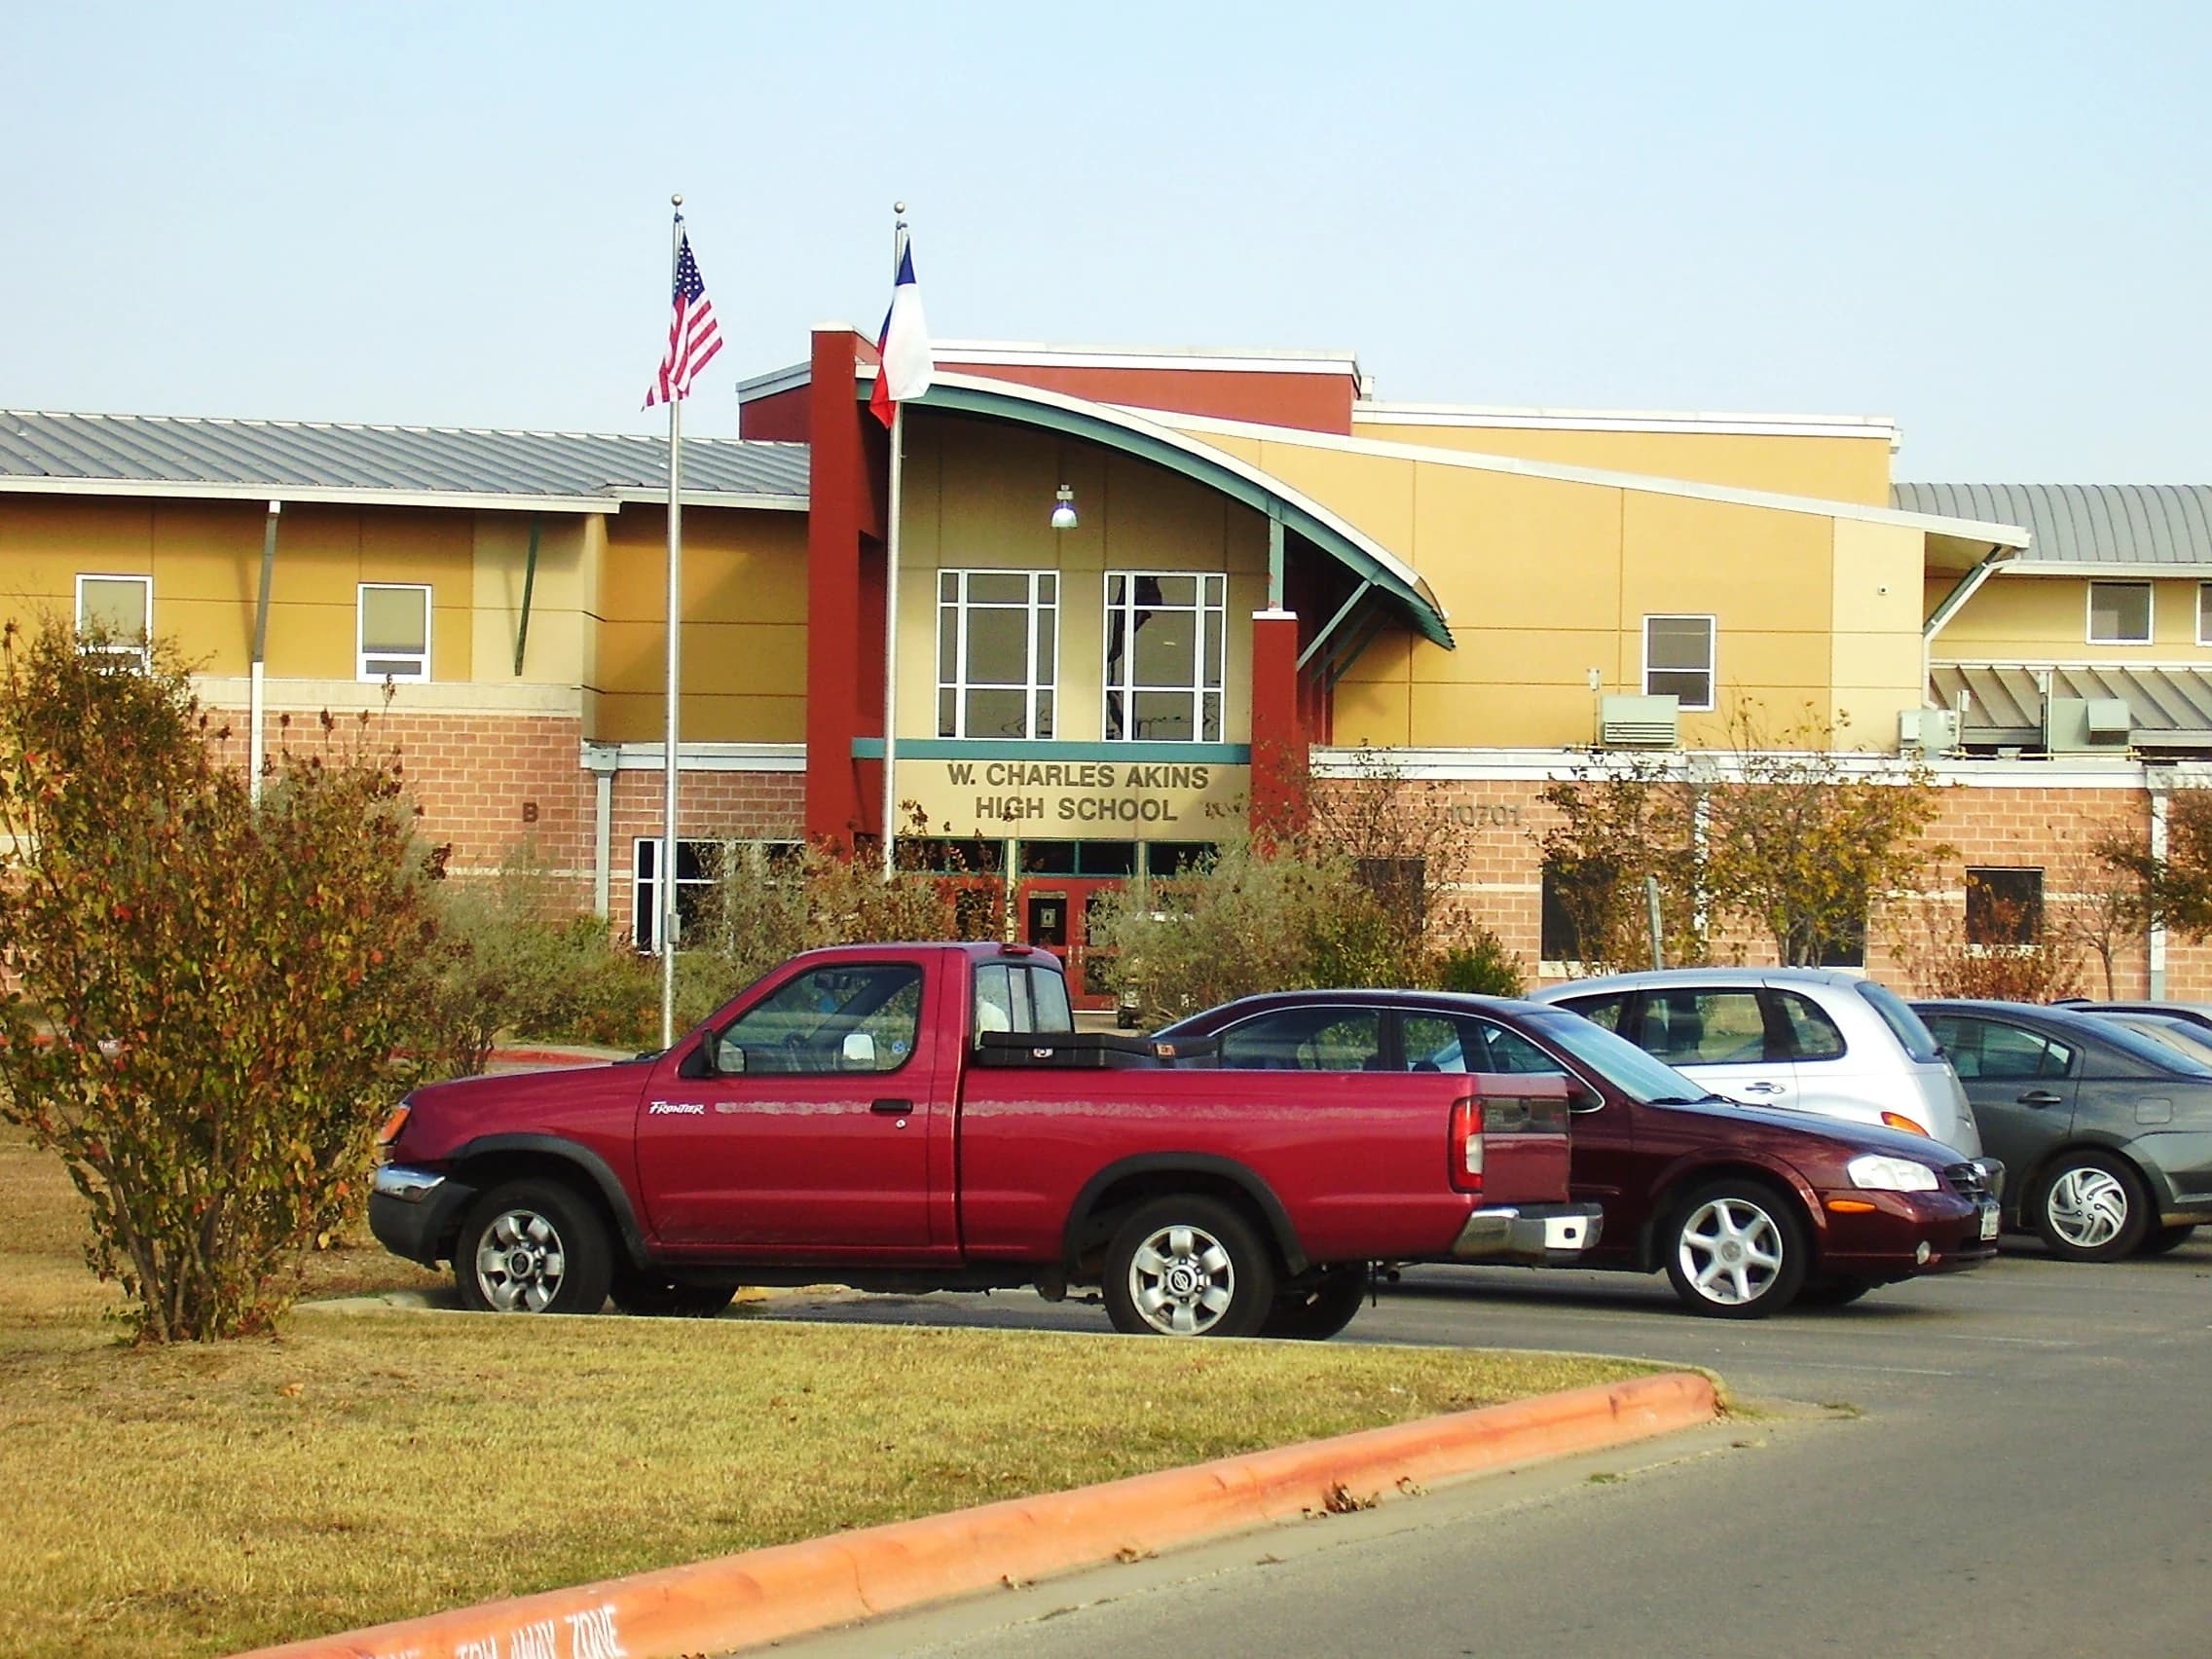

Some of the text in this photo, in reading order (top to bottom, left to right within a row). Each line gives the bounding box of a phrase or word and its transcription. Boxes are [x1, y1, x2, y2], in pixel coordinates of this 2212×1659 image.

[946, 763, 1209, 790] W. CHARLES AKINS
[522, 801, 538, 823] B
[975, 796, 1178, 822] HIGH SCHOOL
[565, 1604, 629, 1659] ZONE
